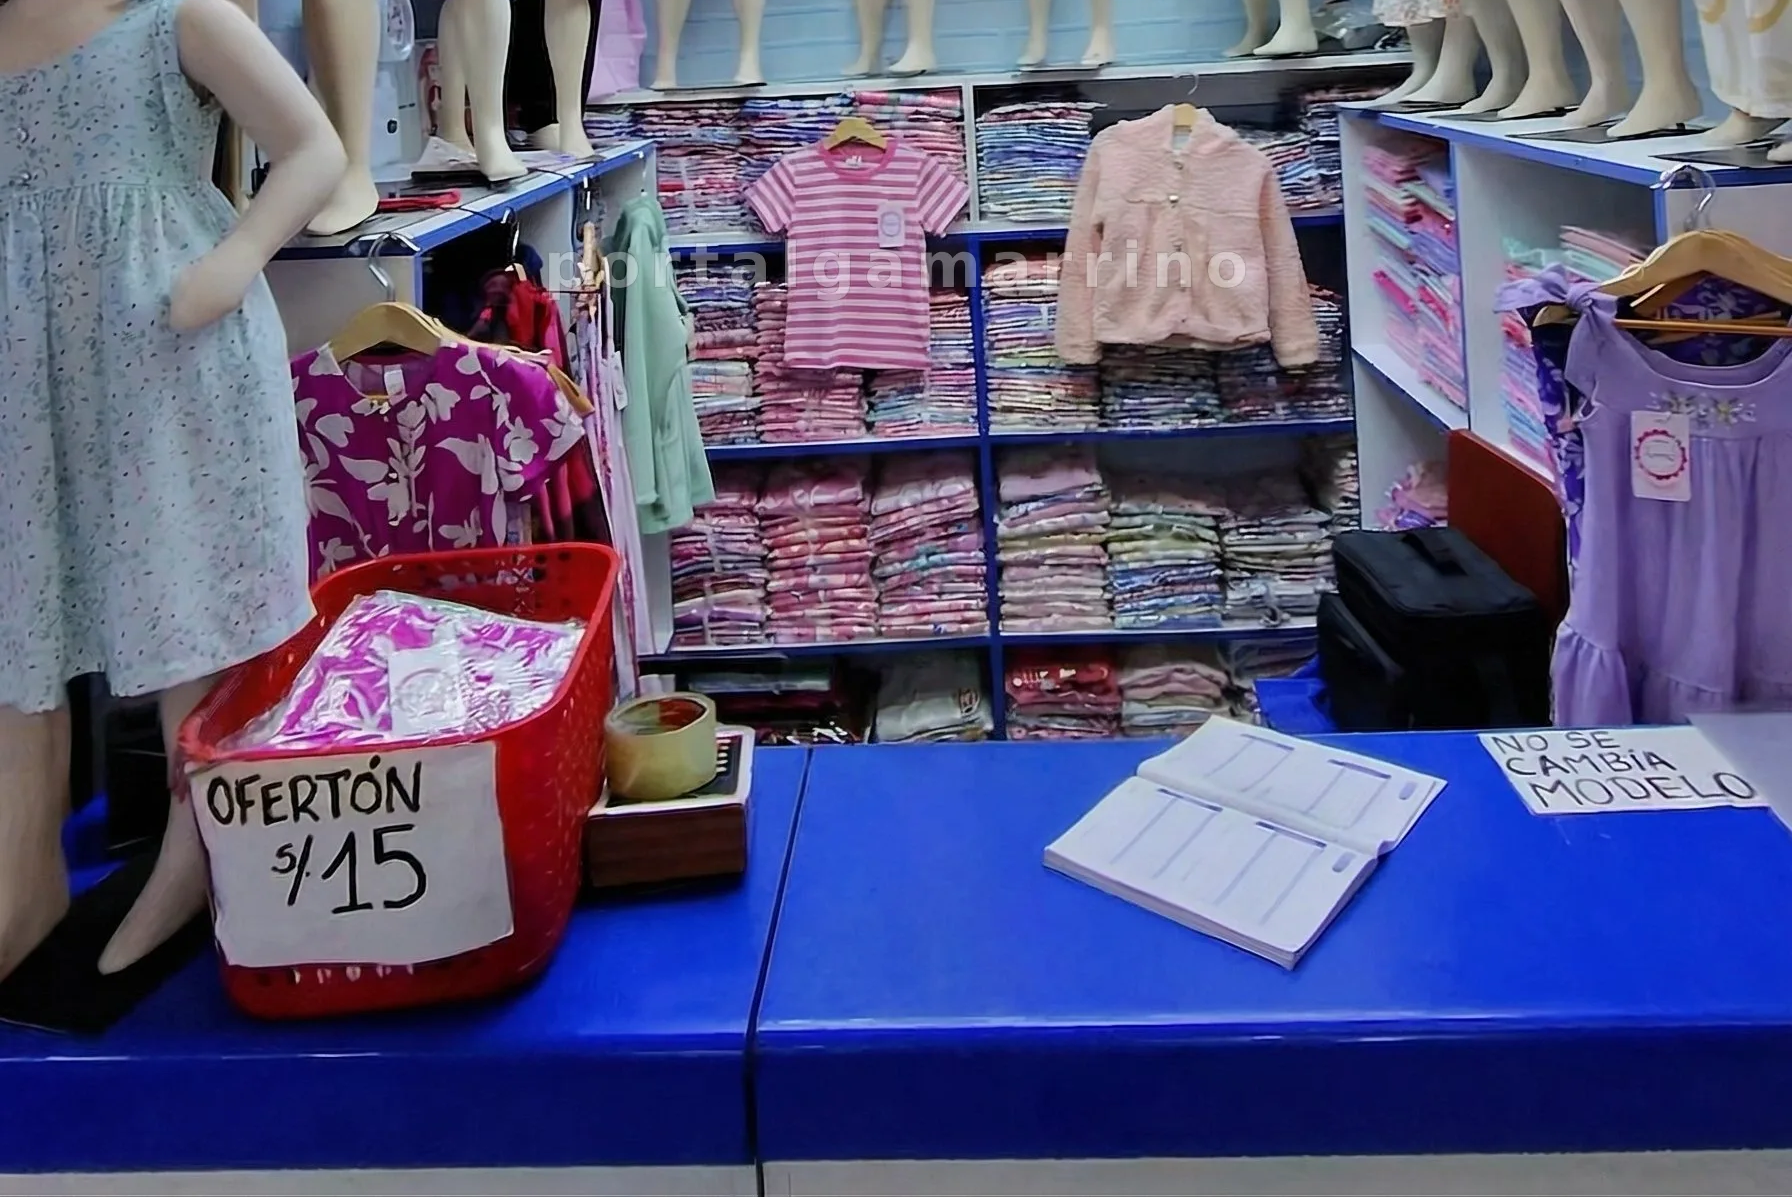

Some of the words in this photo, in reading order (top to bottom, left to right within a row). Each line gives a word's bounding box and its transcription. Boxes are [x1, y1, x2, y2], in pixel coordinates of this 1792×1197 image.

[1492, 734, 1548, 753] NO
[1566, 731, 1620, 749] SE
[206, 755, 421, 825] OFERTÓN
[1529, 772, 1756, 807] MODELO
